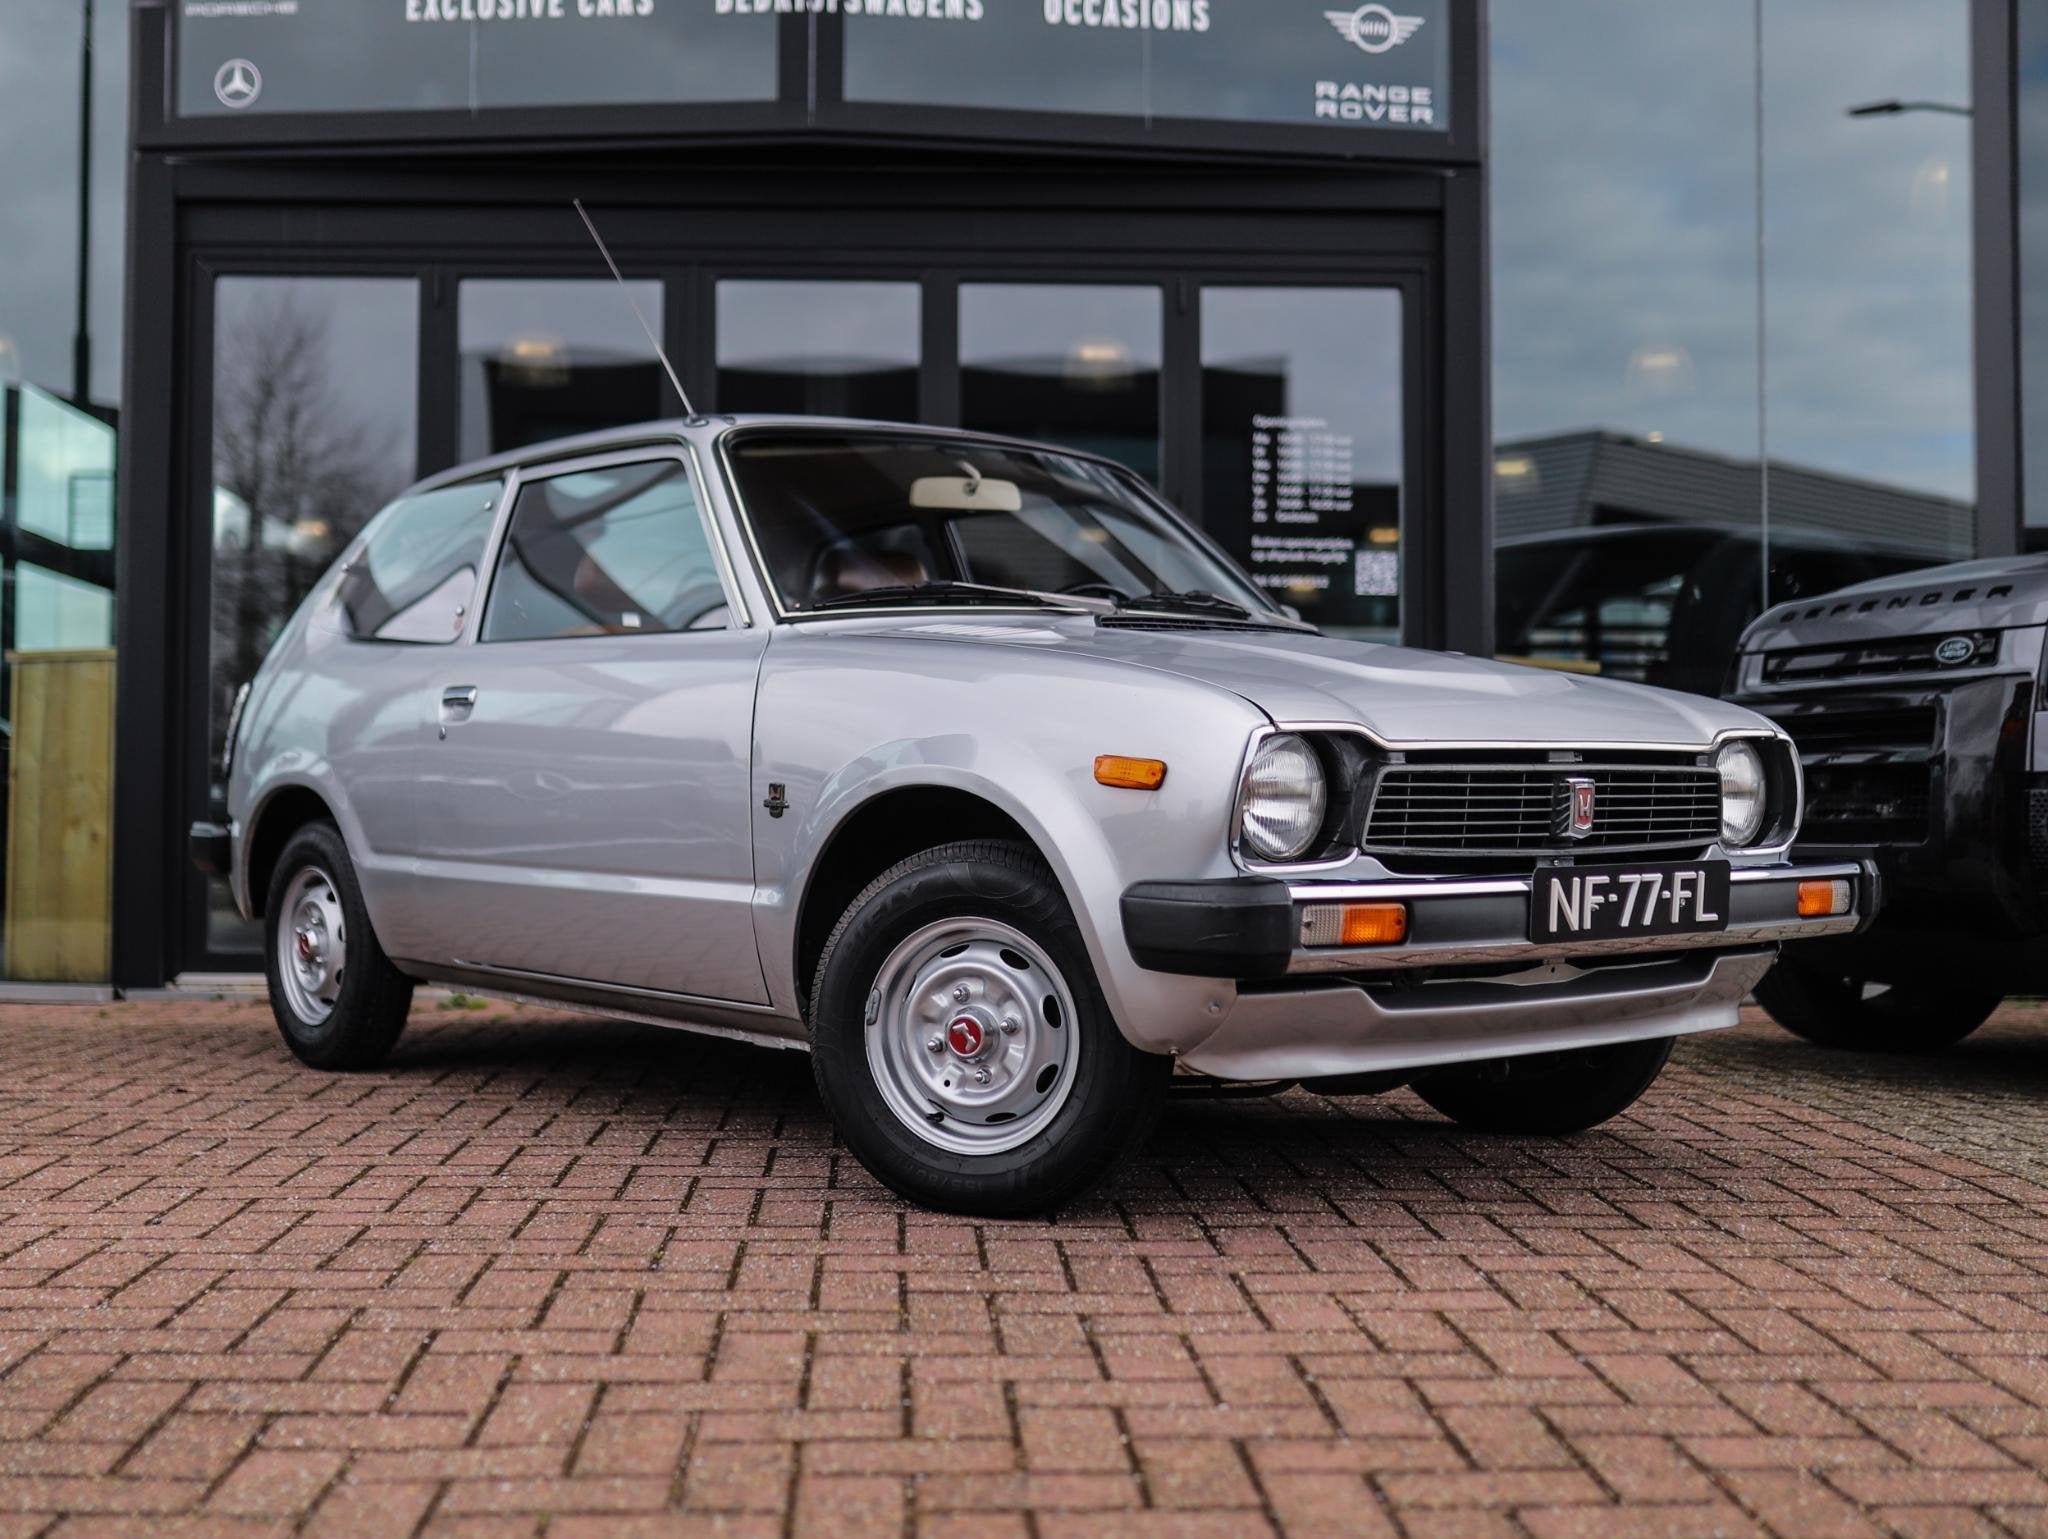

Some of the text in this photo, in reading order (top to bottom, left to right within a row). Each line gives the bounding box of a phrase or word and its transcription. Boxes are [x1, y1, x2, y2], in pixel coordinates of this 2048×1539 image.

[405, 0, 564, 22] EXCLUSIVE
[1043, 0, 1210, 32] OCCASIONS
[1315, 80, 1432, 105] RANGE
[1315, 100, 1433, 124] ROVER
[1549, 870, 1719, 933] NF-77-FL
